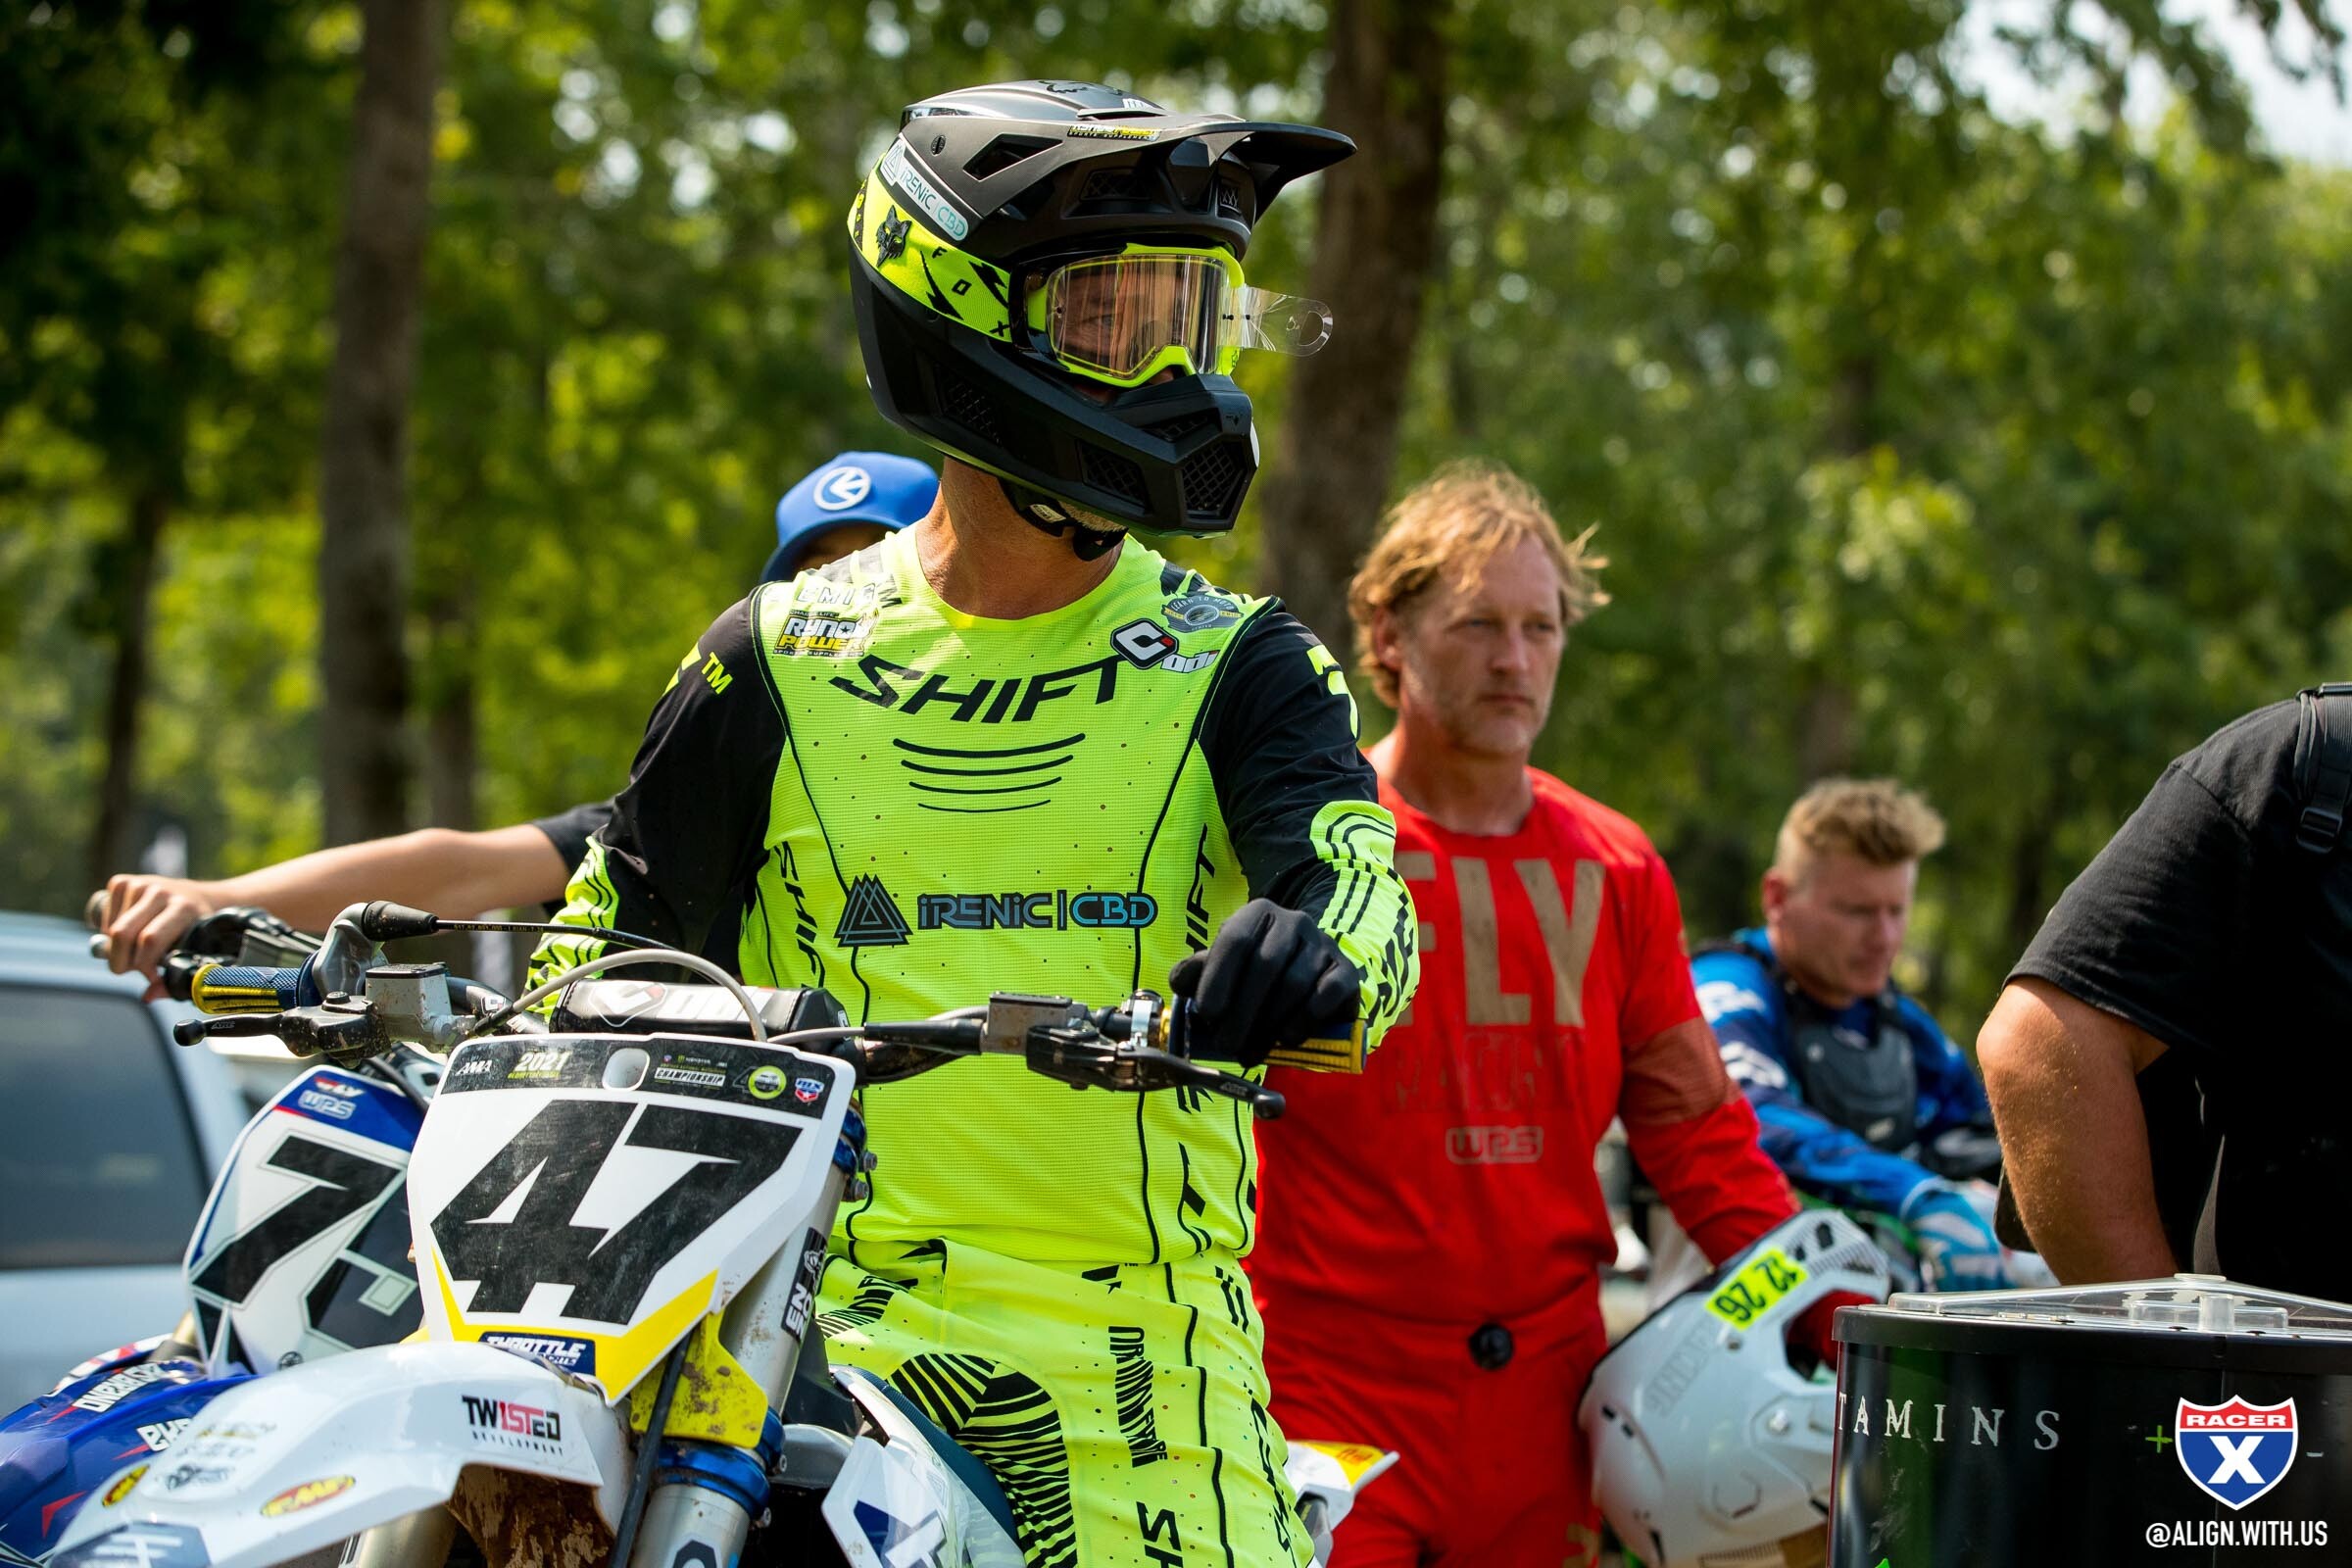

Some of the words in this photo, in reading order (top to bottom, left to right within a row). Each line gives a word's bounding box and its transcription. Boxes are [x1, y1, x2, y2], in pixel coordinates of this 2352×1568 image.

[937, 206, 966, 237] CBD
[1171, 598, 1195, 612] LEARN
[828, 654, 1131, 724] SHIFT
[1069, 893, 1157, 928] CBD
[456, 1059, 494, 1076] AMA
[514, 1051, 574, 1072] 2021
[655, 1067, 726, 1087] CHAMPIONSHIP
[430, 1099, 803, 1325] 47
[1715, 1281, 1767, 1323] 26
[485, 1335, 587, 1358] THROTTLE
[461, 1395, 562, 1442] TWISTED
